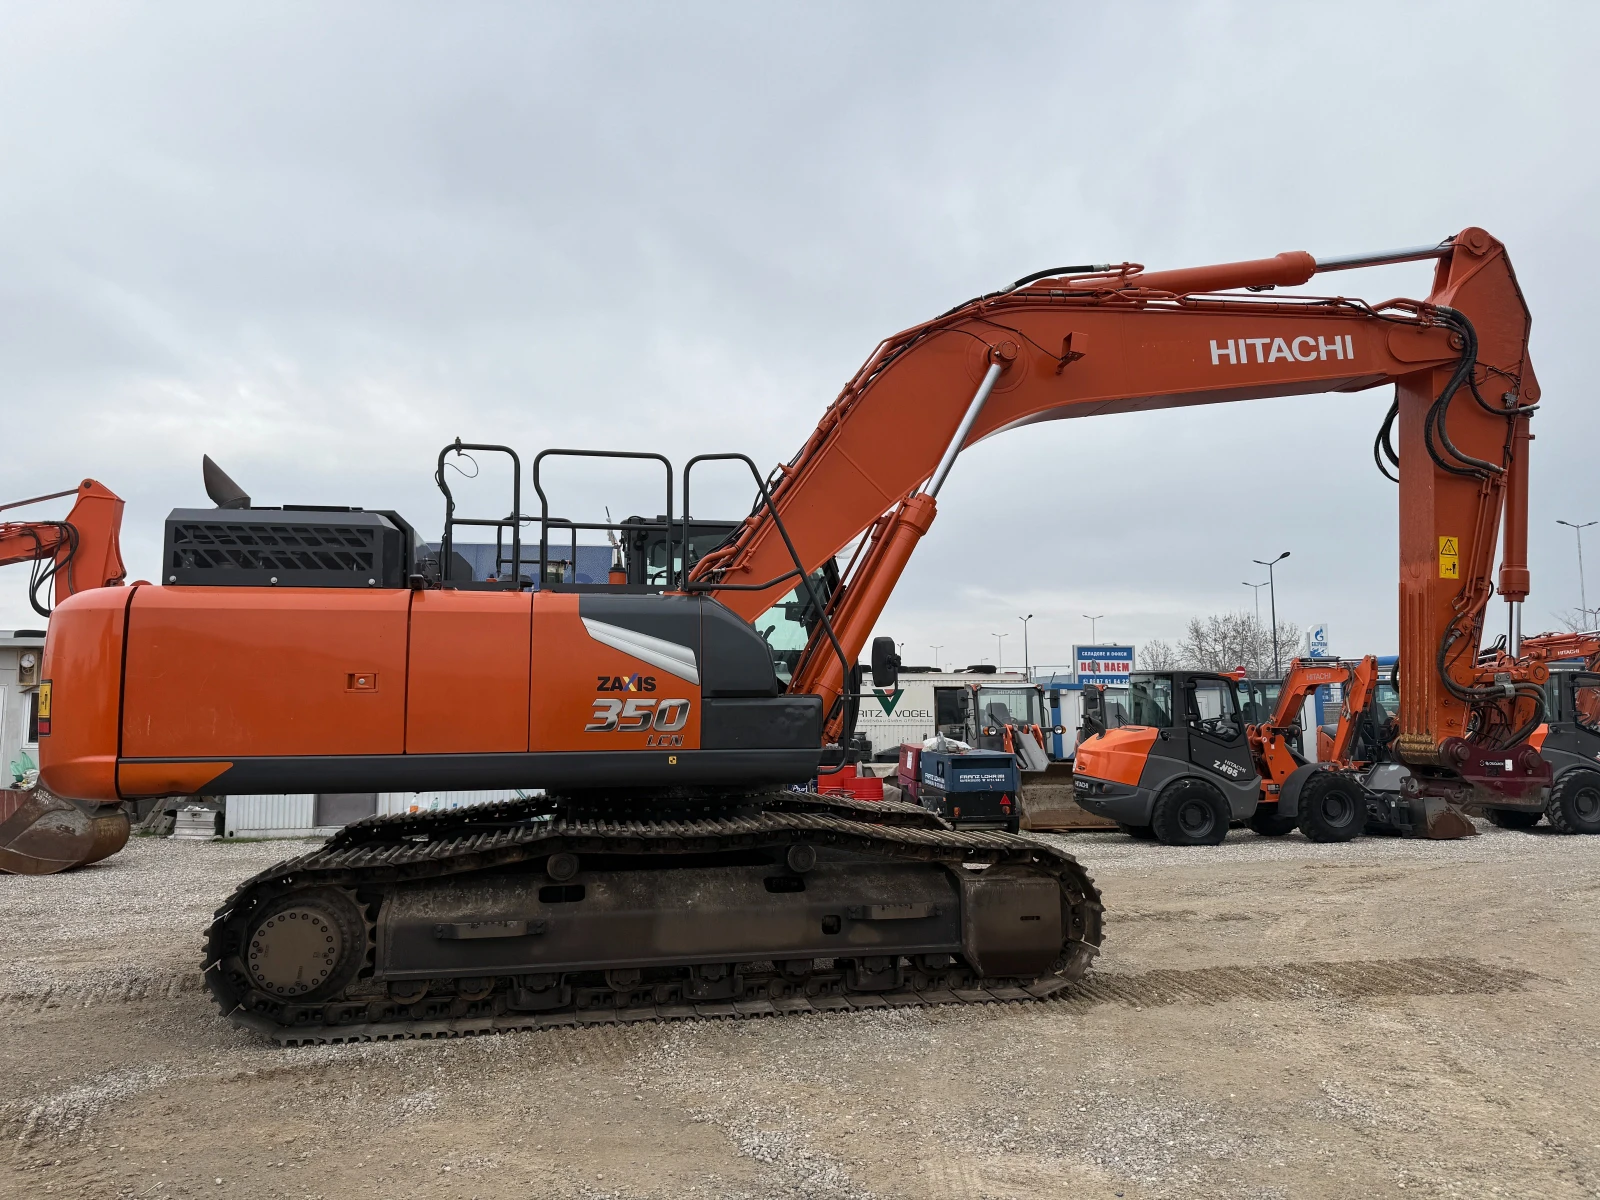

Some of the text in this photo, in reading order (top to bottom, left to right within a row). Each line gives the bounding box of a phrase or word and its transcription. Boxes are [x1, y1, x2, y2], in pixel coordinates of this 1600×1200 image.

[1210, 335, 1354, 365] HITACHI
[1103, 662, 1129, 672] НАЕМ
[597, 673, 656, 692] ZAXIS
[1306, 672, 1332, 681] HITACHI
[584, 698, 691, 732] 350
[894, 709, 933, 718] VOGEL
[646, 735, 684, 747] LCN
